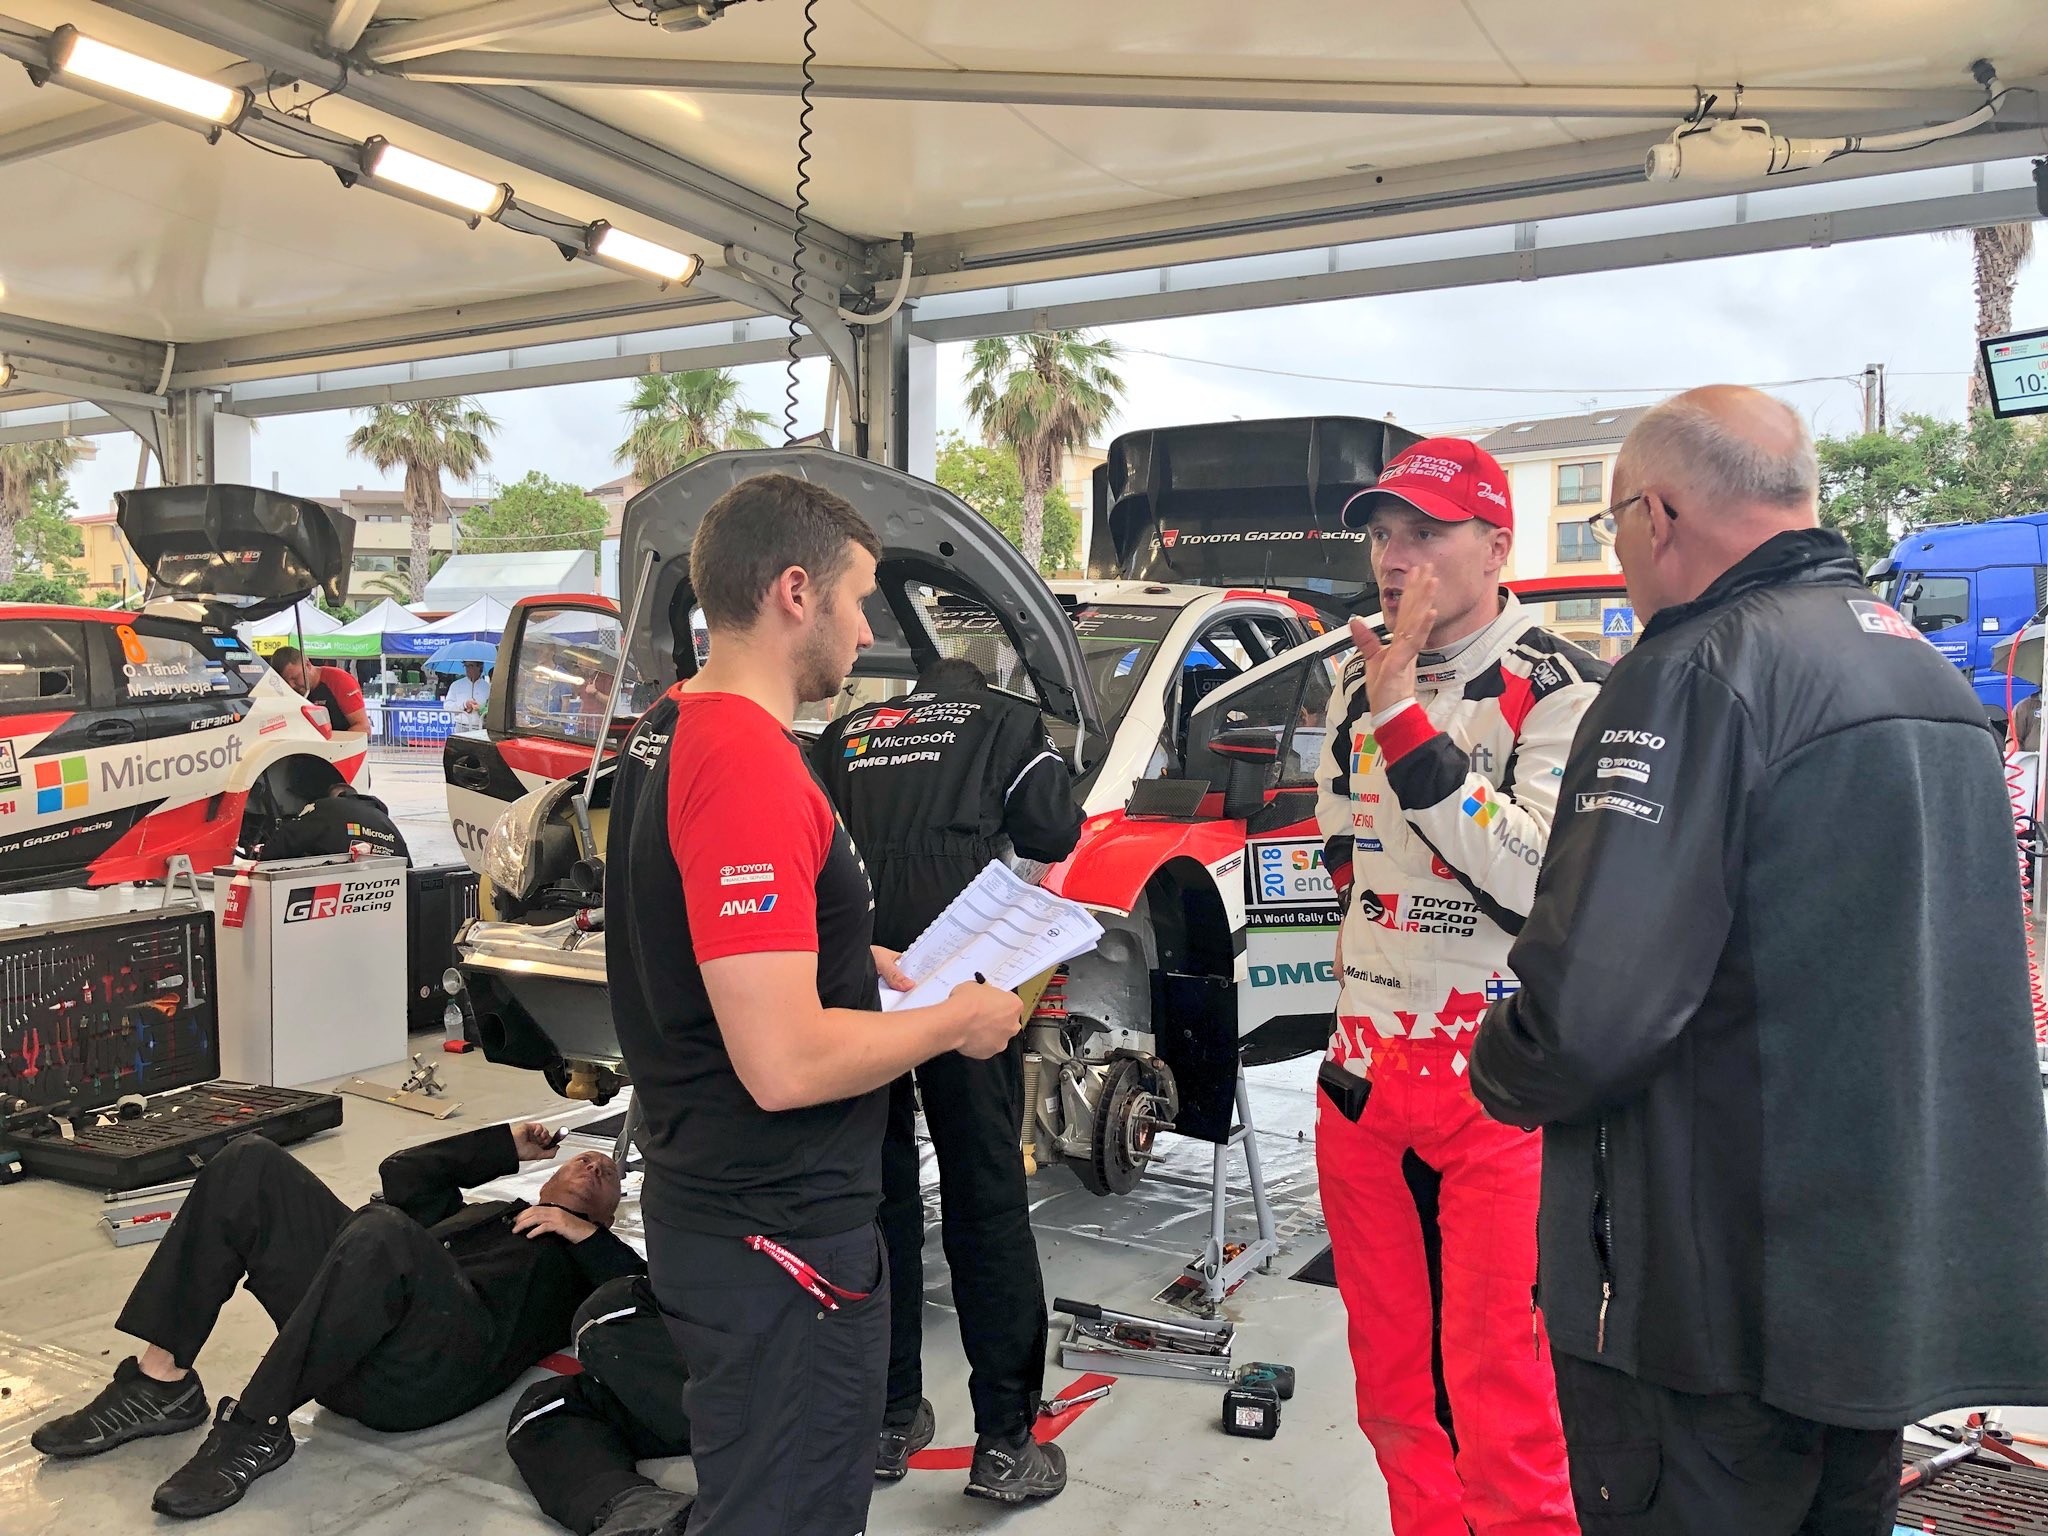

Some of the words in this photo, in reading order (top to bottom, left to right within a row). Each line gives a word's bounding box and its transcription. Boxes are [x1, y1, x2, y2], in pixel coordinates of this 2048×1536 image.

[1411, 462, 1455, 476] GAZOO
[1415, 454, 1462, 472] TOYOTA
[1405, 467, 1451, 483] Racing
[1181, 533, 1240, 545] TOYOTA
[1245, 531, 1305, 540] GAZOO
[1307, 530, 1366, 543] Racing
[1077, 609, 1158, 622] Racing
[116, 624, 148, 664] 8
[413, 638, 451, 646] M-SPORT
[123, 664, 140, 678] O.
[142, 663, 188, 677] Tänak
[127, 682, 147, 697] M.
[151, 680, 212, 697] Järveoja
[903, 714, 966, 725] Racing
[872, 730, 957, 748] Microsoft
[1600, 730, 1665, 750] DENSO
[100, 735, 243, 793] Microsoft
[848, 756, 889, 772] DMG
[890, 751, 941, 766] MORI
[1613, 758, 1651, 773] TOYOTA
[23, 831, 69, 848] GAZOO
[72, 820, 113, 836] Racing
[362, 827, 395, 843] Microsoft
[735, 863, 774, 873] TOYOTA
[1262, 848, 1286, 897] 2018
[345, 878, 401, 892] TOYOTA
[286, 897, 338, 922] GR
[343, 890, 395, 903] GAZOO
[340, 901, 392, 915] Racing
[719, 899, 758, 917] ANA
[1411, 895, 1482, 914] TOYOTA
[1245, 914, 1262, 924] FIA
[1264, 913, 1295, 924] World
[1297, 912, 1324, 924] Rally
[1408, 909, 1478, 925] GAZOO
[1405, 921, 1474, 937] Racing
[1370, 972, 1401, 988] Latvala
